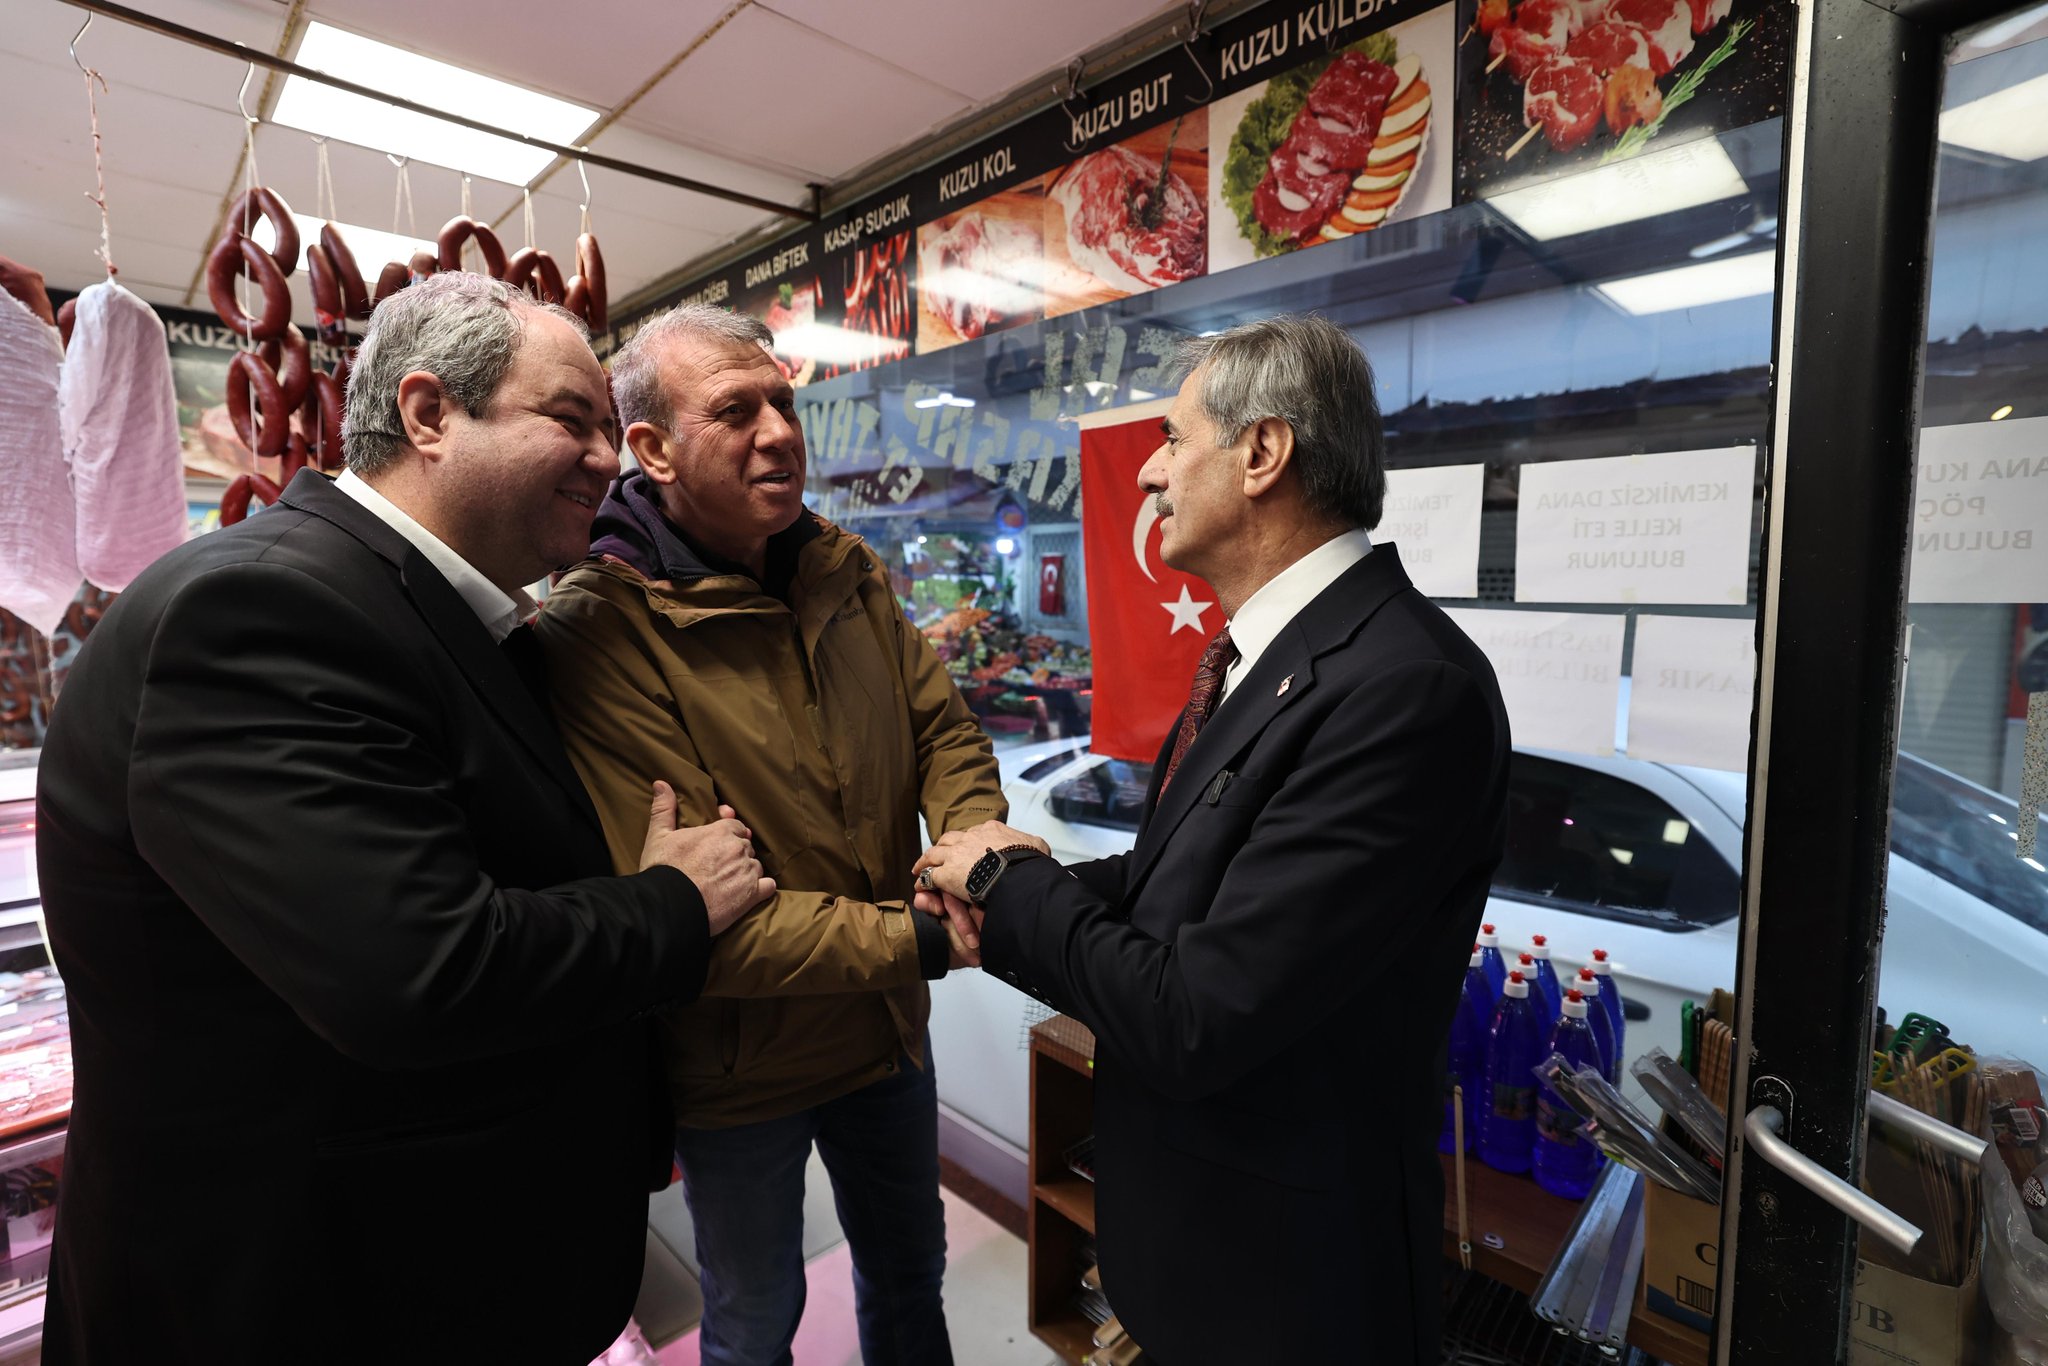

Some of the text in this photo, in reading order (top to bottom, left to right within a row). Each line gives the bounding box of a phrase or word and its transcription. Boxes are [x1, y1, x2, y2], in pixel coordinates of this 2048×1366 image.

[1221, 19, 1289, 81] KUZU
[1072, 72, 1172, 145] KUZU BUT
[939, 146, 1016, 202] KUZU KOL
[824, 194, 911, 254] KASAP SUCUK
[745, 241, 809, 289] DANA BİFTEK
